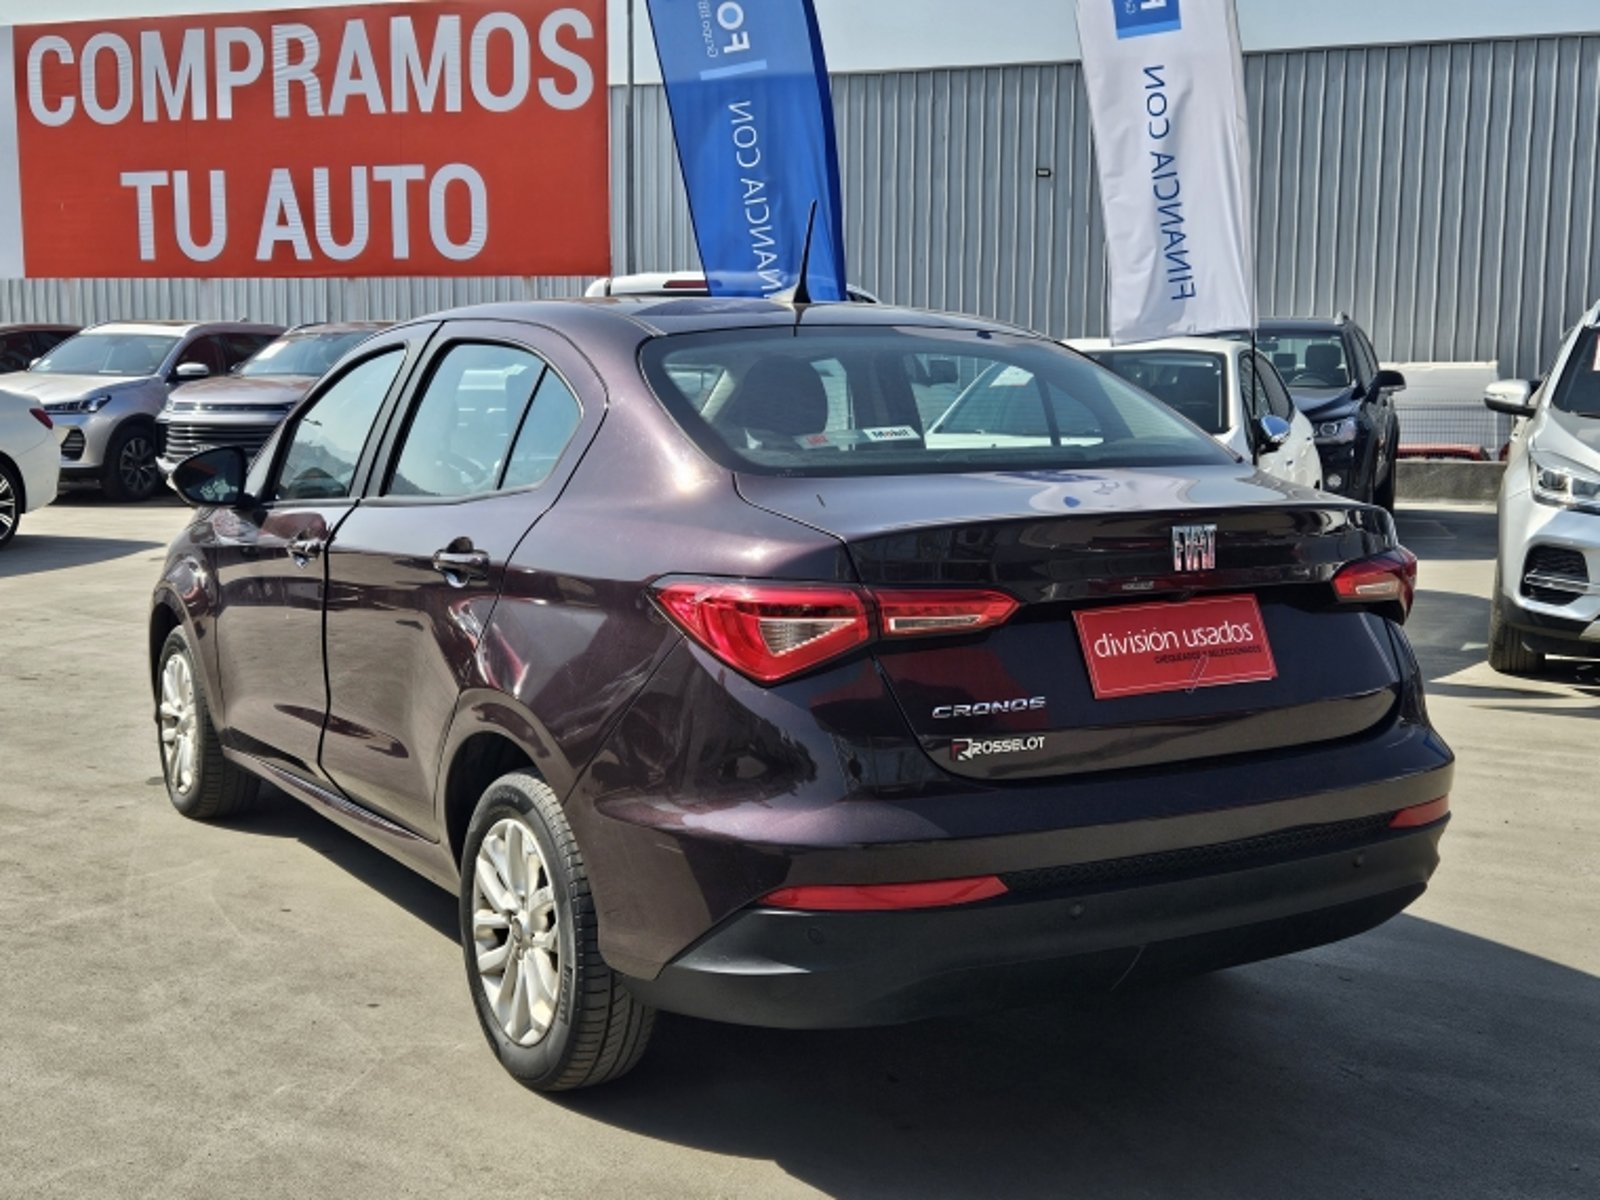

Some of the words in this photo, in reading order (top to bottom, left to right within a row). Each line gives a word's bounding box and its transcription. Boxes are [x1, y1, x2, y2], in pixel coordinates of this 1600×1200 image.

[27, 8, 595, 126] COMPRAMOS
[120, 169, 227, 261] TU
[255, 163, 488, 261] AUTO
[1171, 523, 1217, 572] FIAT
[1094, 626, 1180, 658] división
[1182, 620, 1254, 648] usados
[931, 696, 1046, 719] CRONOS
